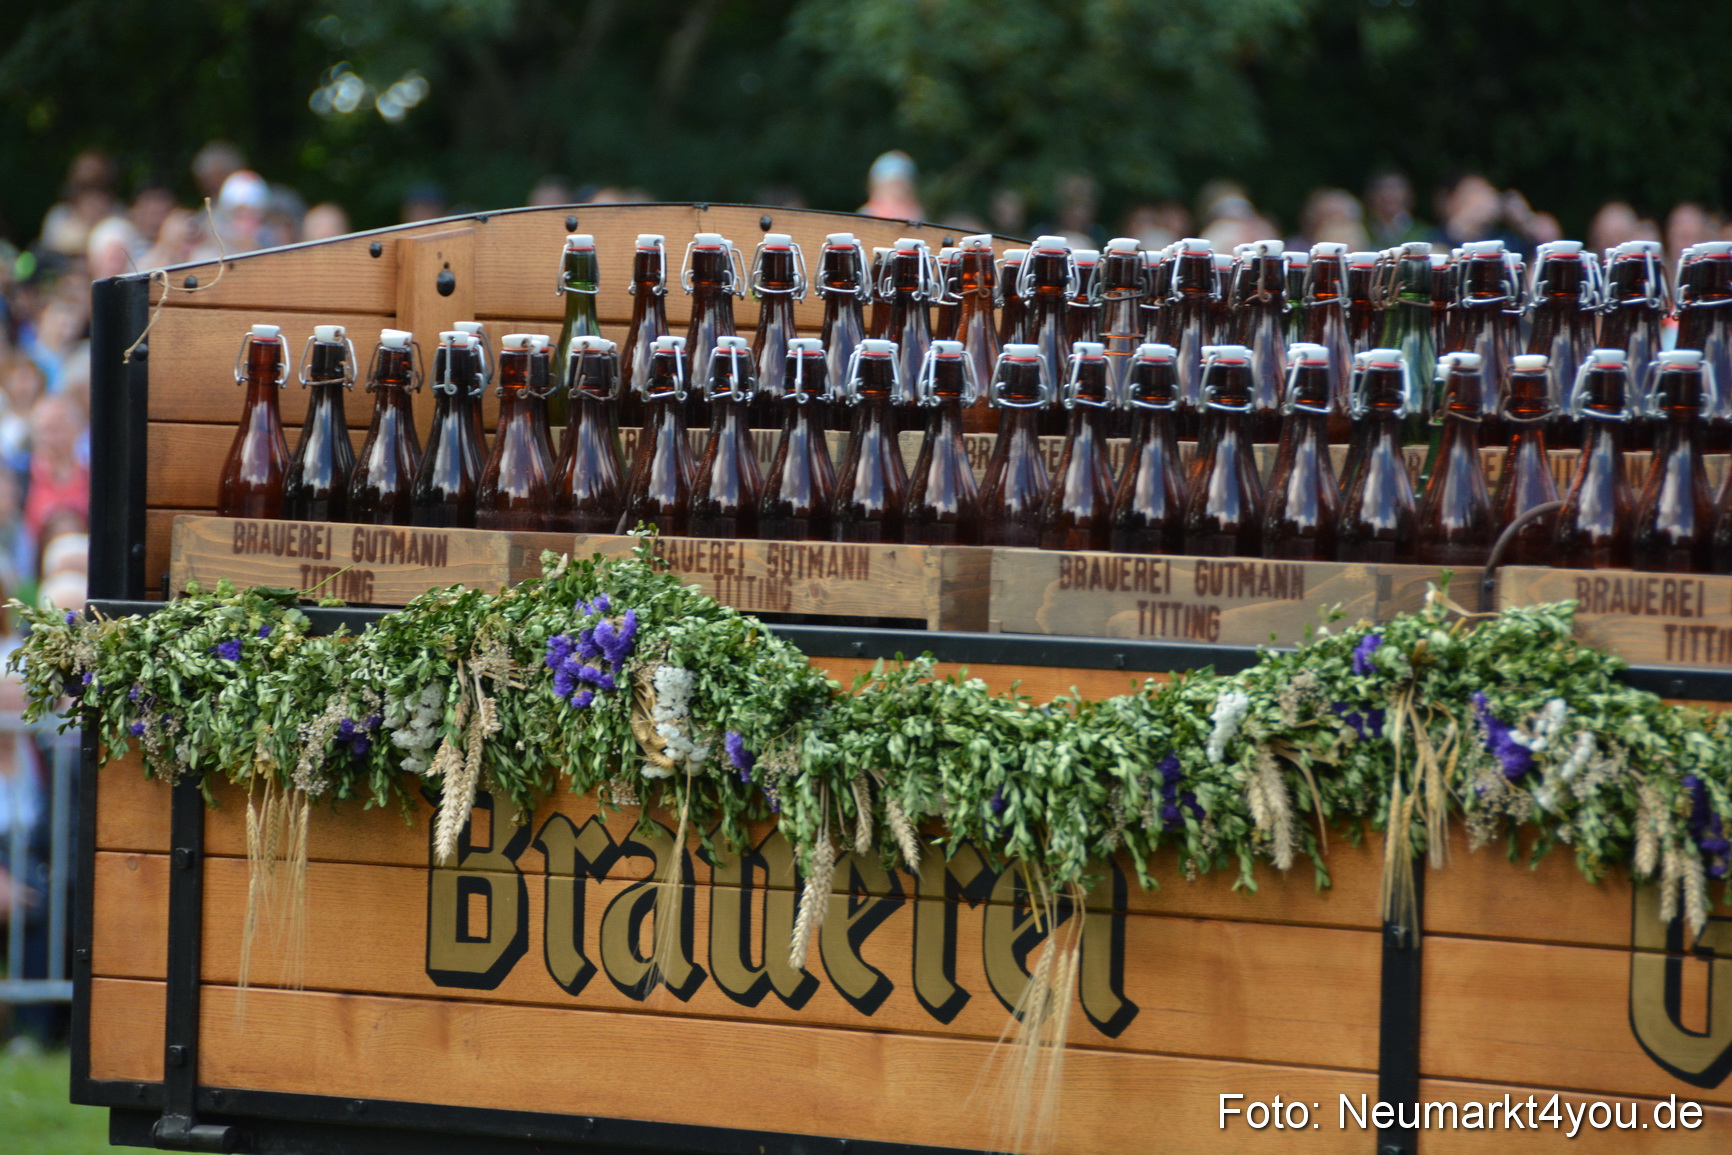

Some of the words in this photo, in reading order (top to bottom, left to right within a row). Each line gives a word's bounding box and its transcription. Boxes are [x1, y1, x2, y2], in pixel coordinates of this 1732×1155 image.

[232, 521, 332, 561] BRAUEREI
[351, 526, 448, 567] GUTMANN
[300, 564, 375, 603] TITTING
[713, 574, 792, 611] TITTING
[1058, 555, 1171, 594] BRAUEREI
[1194, 559, 1304, 600] GUTMANN
[1575, 576, 1705, 617] BRAUEREI
[1137, 600, 1221, 642] TITTING
